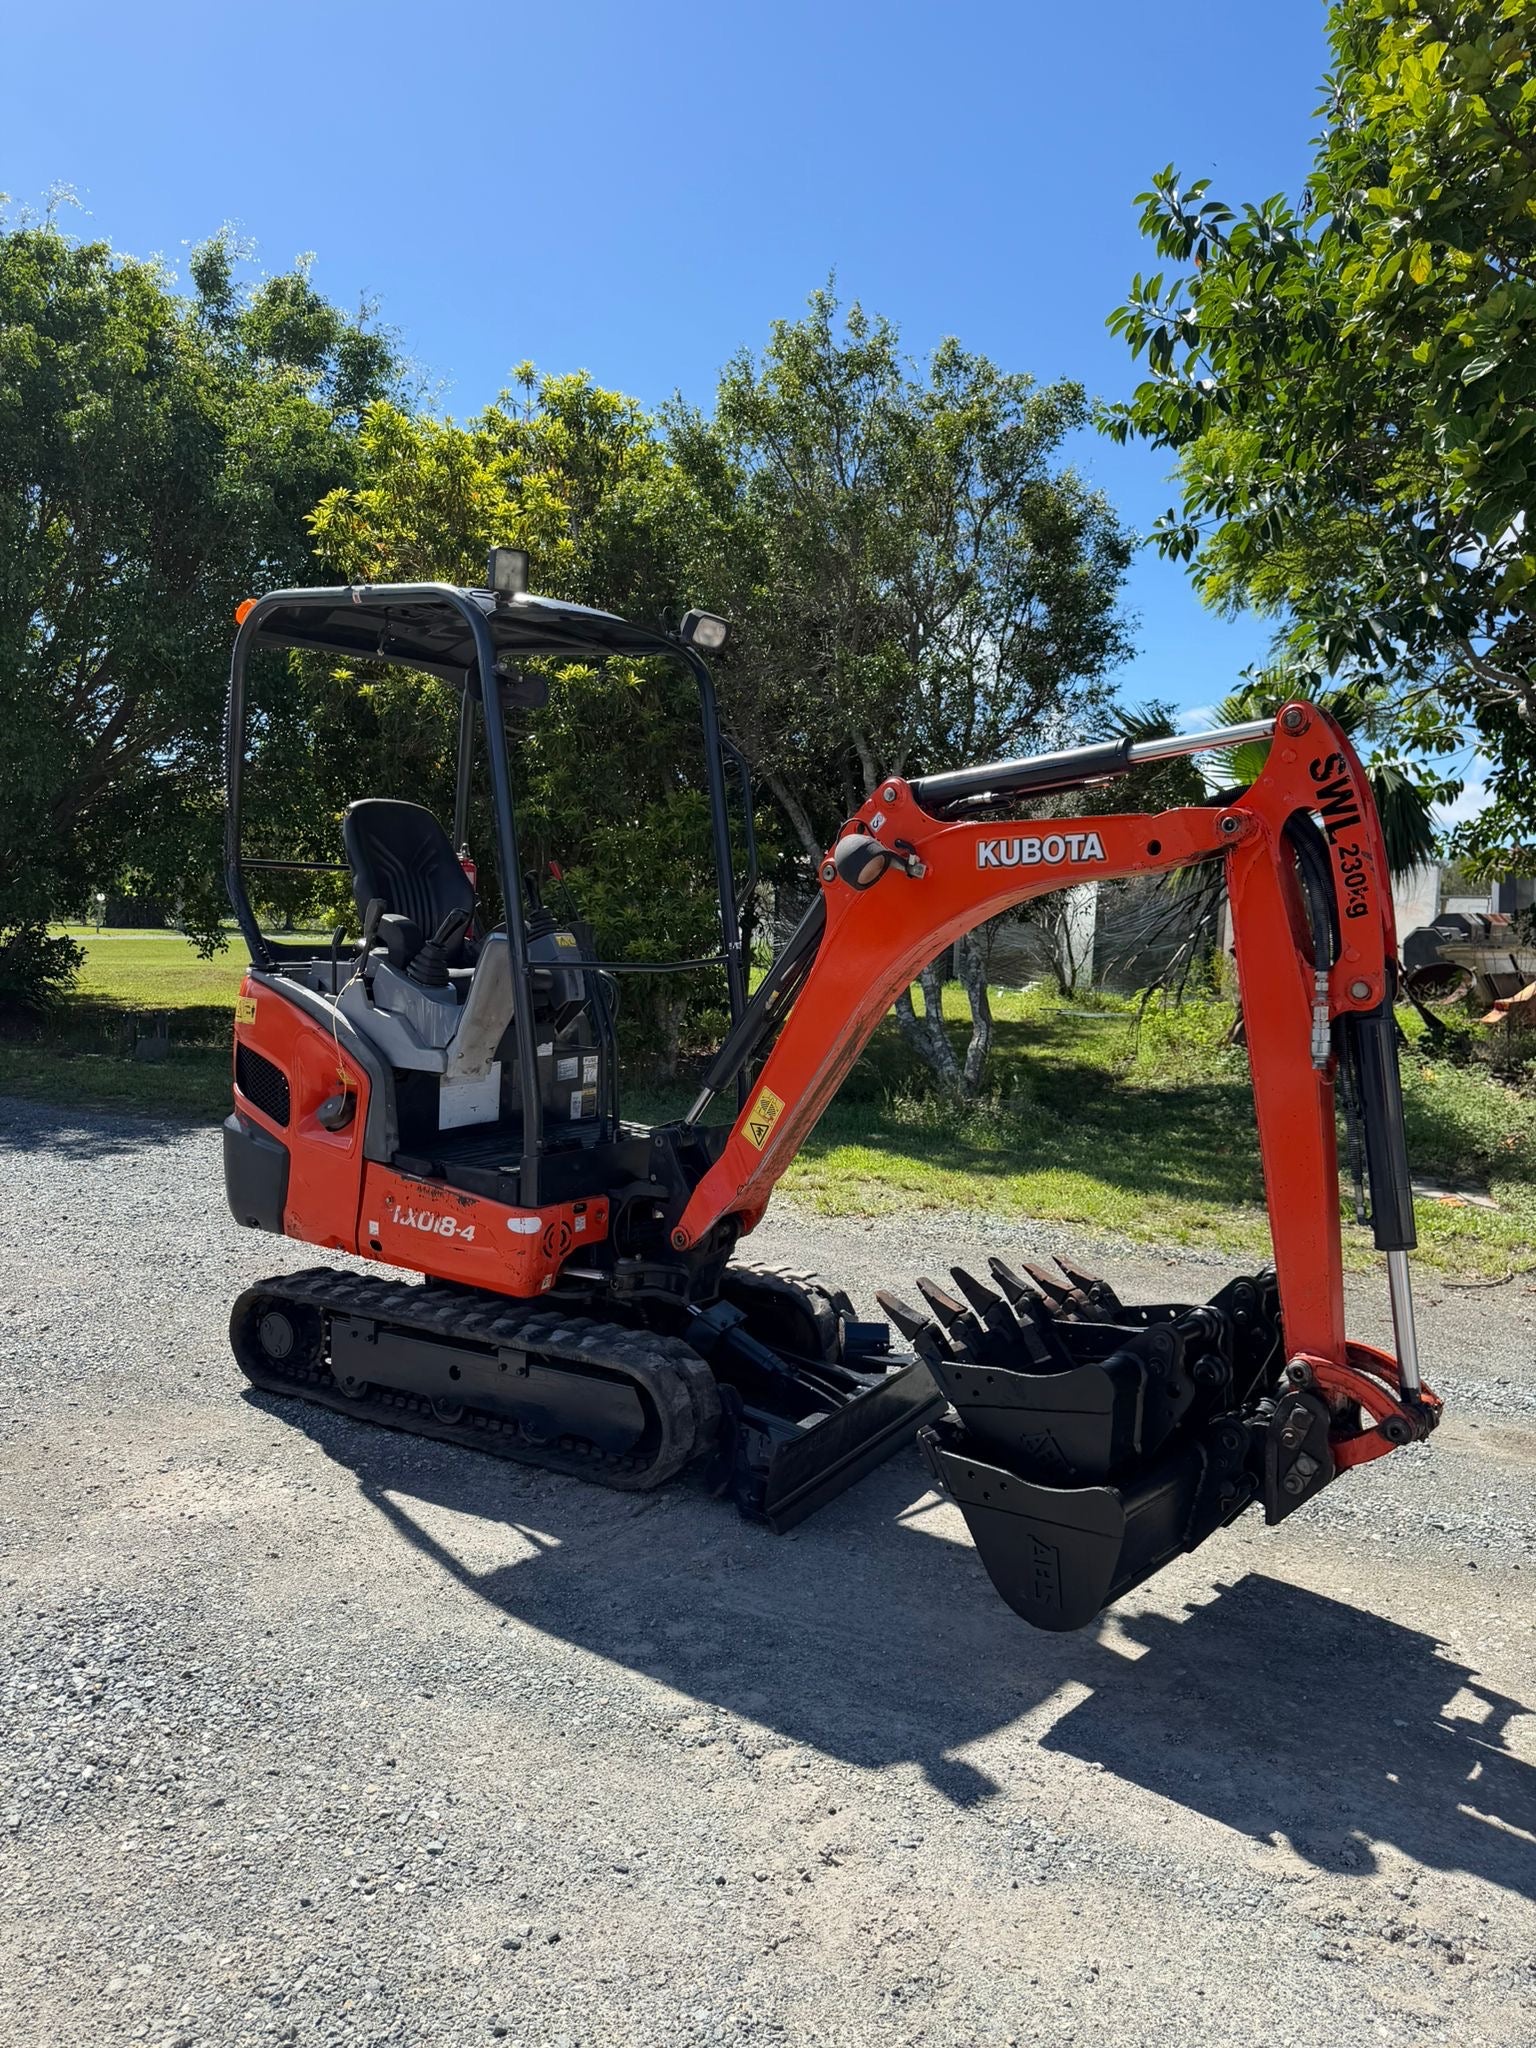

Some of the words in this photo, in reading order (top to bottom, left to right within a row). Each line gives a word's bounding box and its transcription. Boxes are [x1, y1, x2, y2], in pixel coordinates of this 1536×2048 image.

[978, 832, 1106, 868] KUBOTA
[1309, 752, 1361, 845] SWL
[1338, 843, 1369, 919] 230kg
